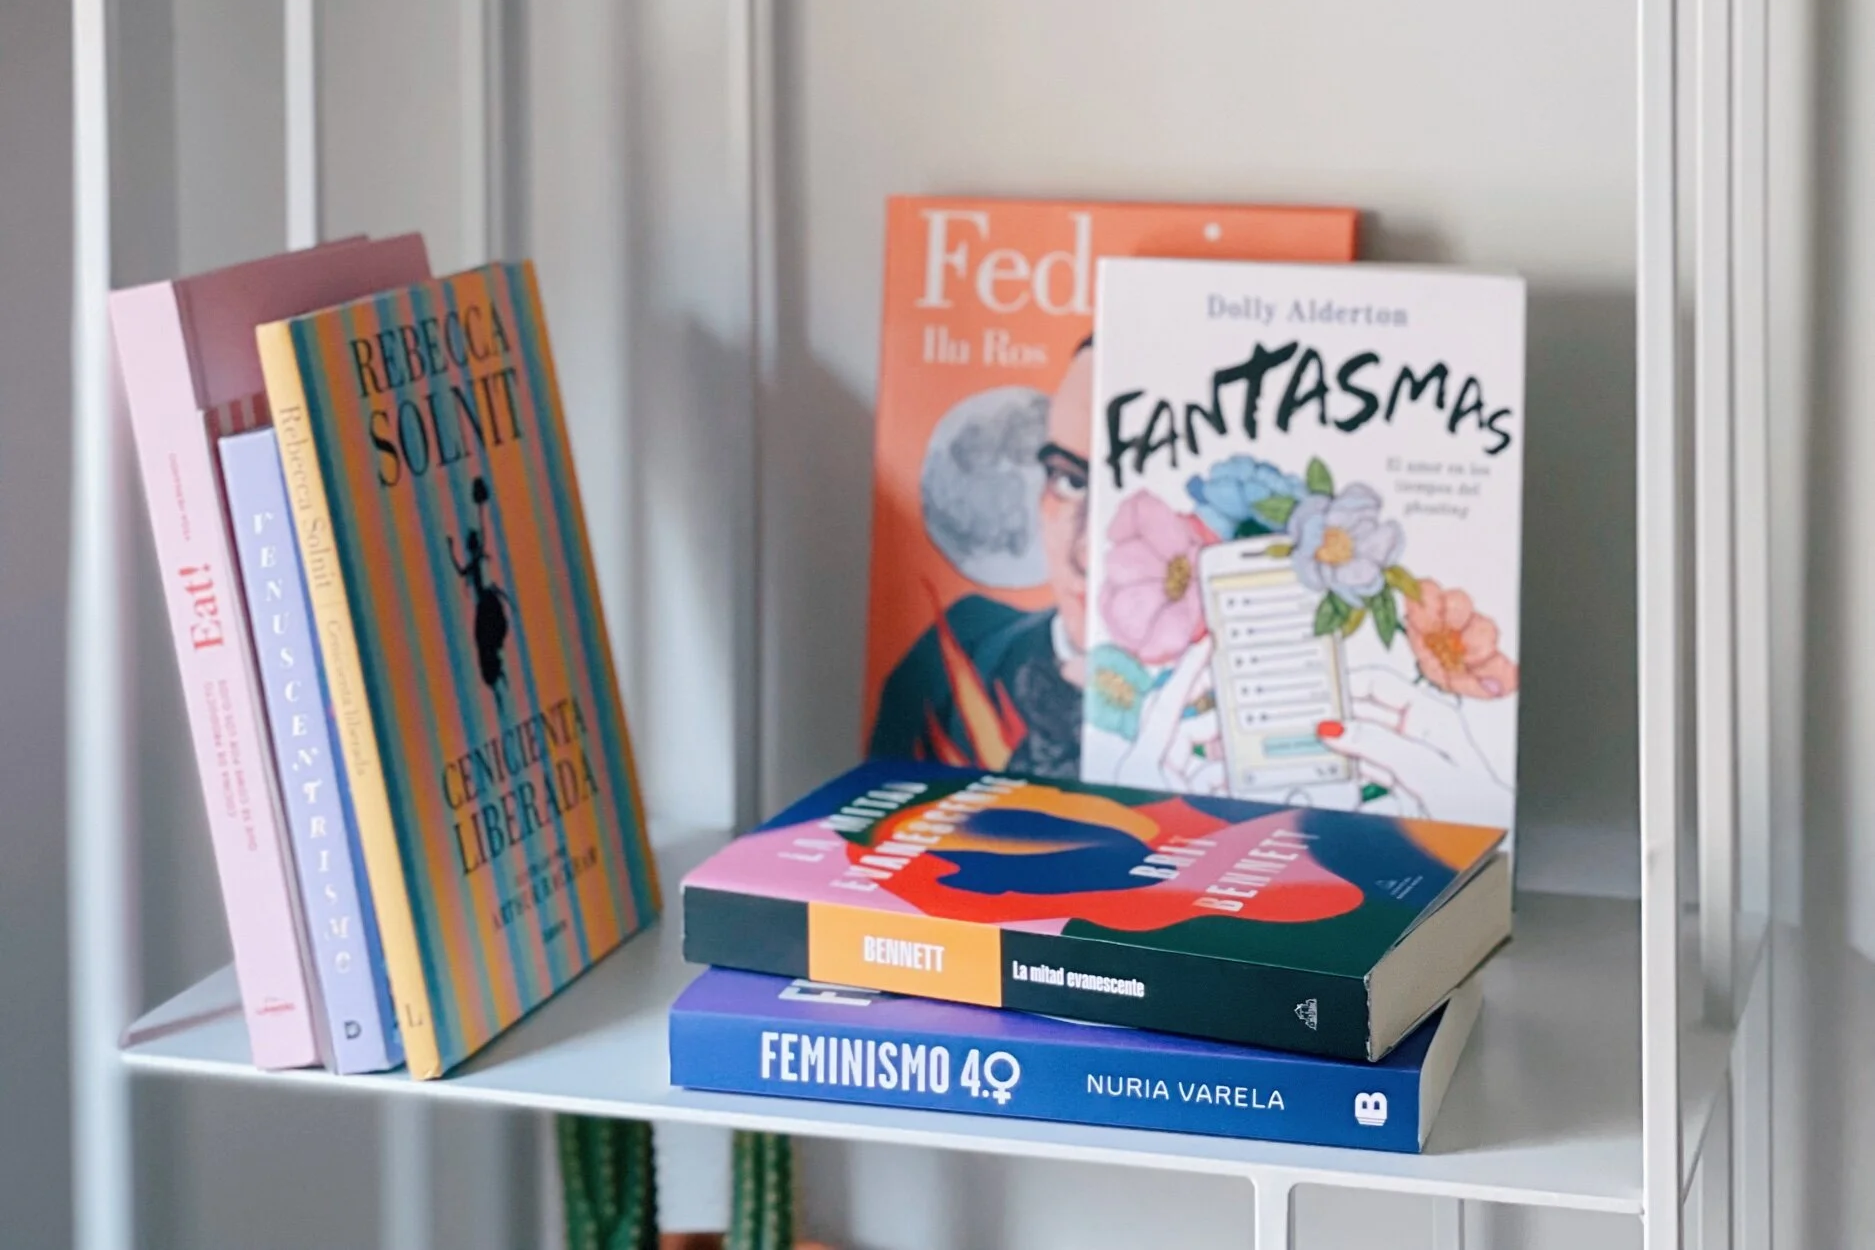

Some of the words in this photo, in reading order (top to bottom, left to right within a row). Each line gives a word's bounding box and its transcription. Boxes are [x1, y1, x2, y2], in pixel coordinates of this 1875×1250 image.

[915, 208, 1094, 316] Fed
[349, 301, 513, 398] REBECCA
[1206, 293, 1276, 325] Dolly
[1286, 294, 1408, 328] Alderton
[369, 368, 526, 488] SOLNIT
[1105, 339, 1513, 488] FANTASMAS
[279, 406, 313, 511] Rebecca
[304, 517, 335, 588] Solnit
[178, 563, 225, 650] Eat!
[442, 696, 590, 811] CENICIENTA
[453, 754, 599, 877] LIBERADA
[777, 837, 845, 862] LA
[1128, 835, 1217, 880] BRIT
[1192, 829, 1320, 912] BENNETT
[863, 936, 945, 973] BENNETT
[1012, 959, 1028, 981] La
[1029, 964, 1065, 986] mitad
[1066, 970, 1145, 998] evanescente
[761, 1031, 950, 1094] FEMINISMO
[1087, 1073, 1169, 1100] NURIA
[1179, 1081, 1285, 1111] VARELA
